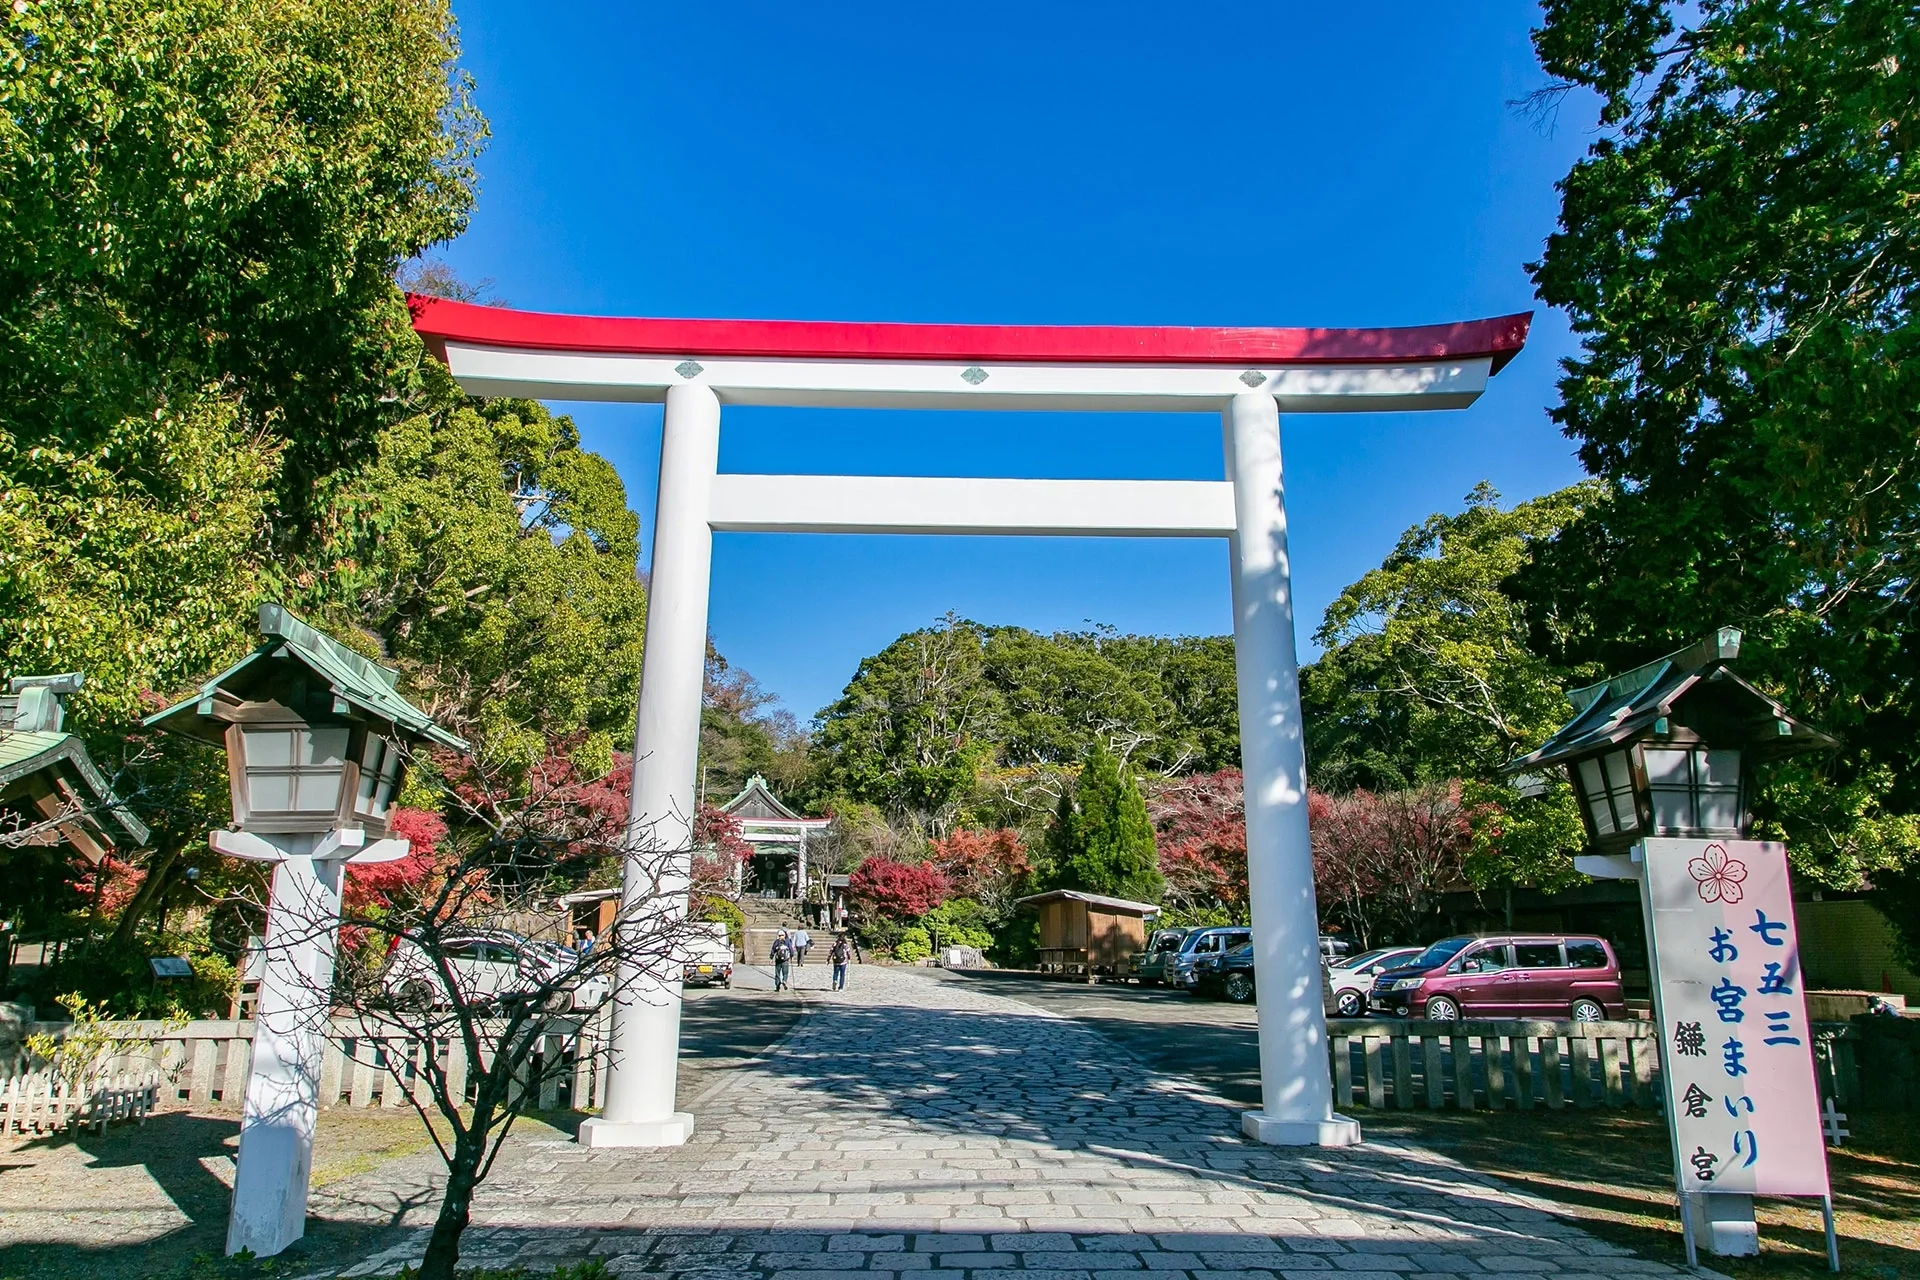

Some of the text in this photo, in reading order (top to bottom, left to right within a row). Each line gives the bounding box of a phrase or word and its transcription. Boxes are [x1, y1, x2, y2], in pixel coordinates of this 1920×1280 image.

[1709, 926, 1758, 1170] お宮まいり
[1750, 909, 1800, 1047] 七五三
[1673, 1020, 1718, 1181] 鎌倉宮
